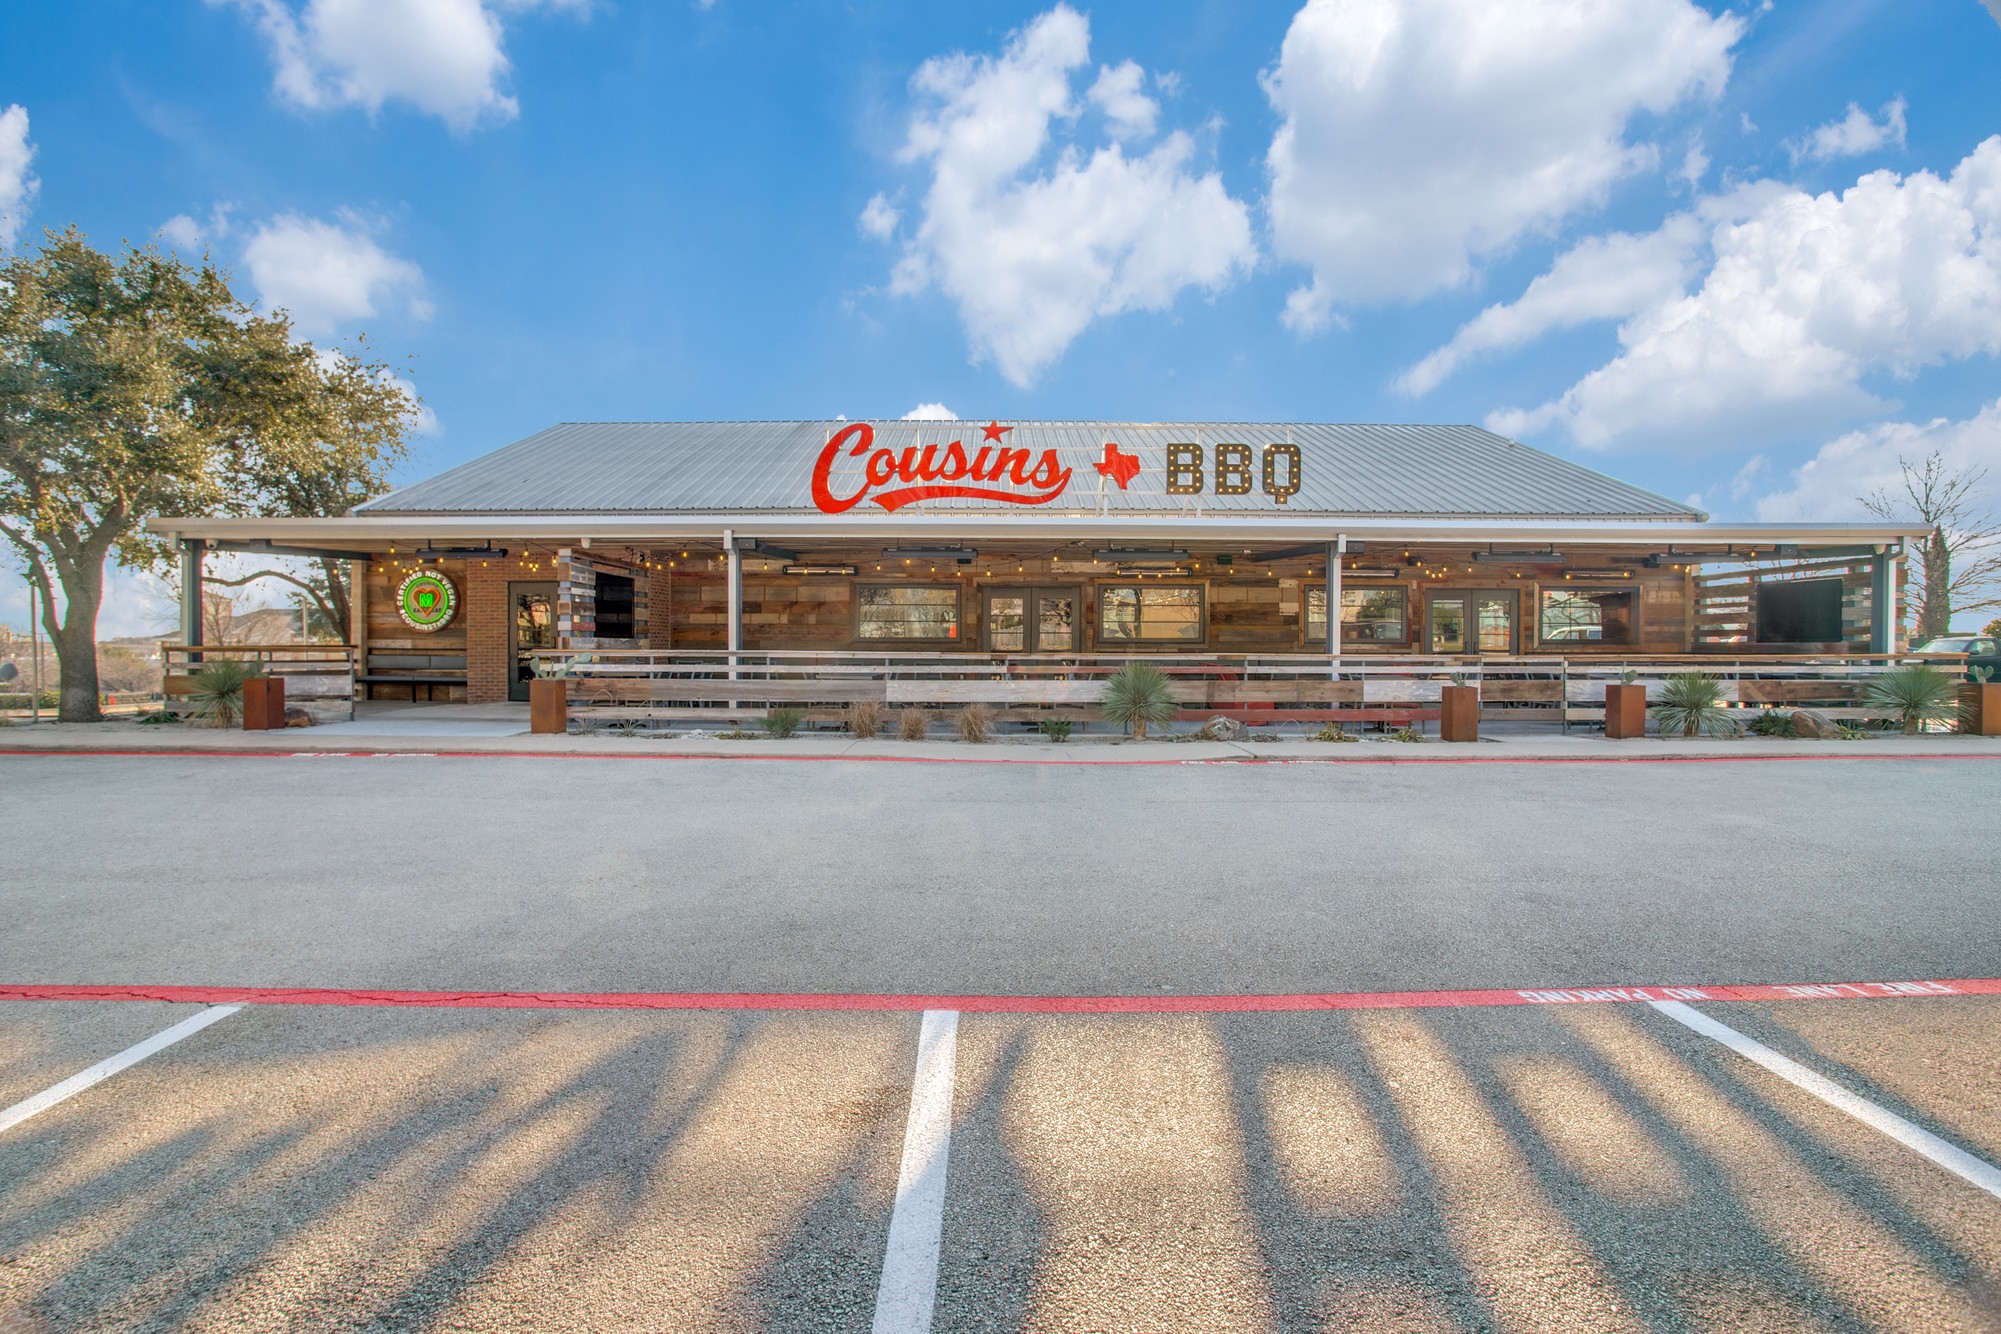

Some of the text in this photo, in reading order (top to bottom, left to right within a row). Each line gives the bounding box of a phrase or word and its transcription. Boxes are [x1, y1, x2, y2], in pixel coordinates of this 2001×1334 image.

[811, 420, 1300, 513] Cousins BBQ
[396, 570, 456, 606] CERTIFIED NOT VEGAN
[419, 593, 434, 607] M
[1516, 981, 1958, 1003] FIRE LANE NO PARKING
